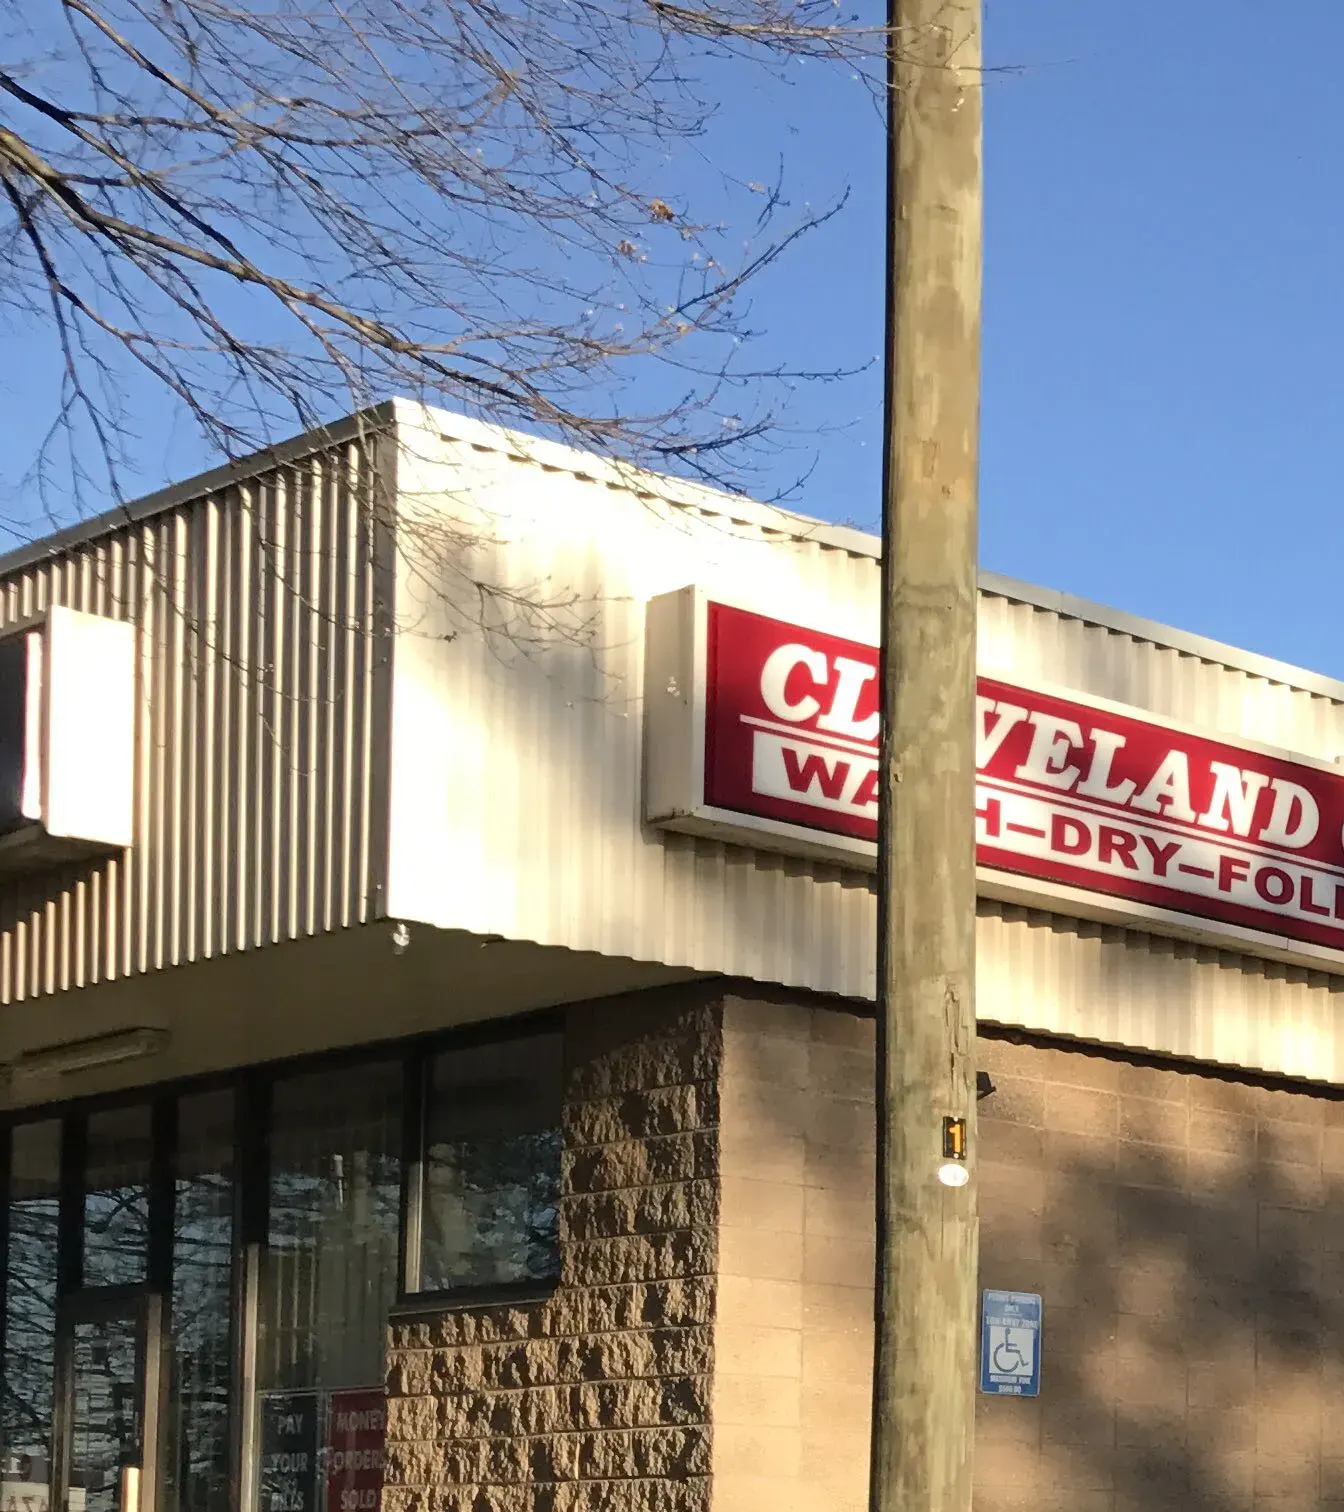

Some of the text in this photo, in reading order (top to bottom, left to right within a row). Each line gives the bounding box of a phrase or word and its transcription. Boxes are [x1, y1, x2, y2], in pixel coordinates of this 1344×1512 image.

[760, 643, 1320, 849] CLVELAND
[949, 1123, 961, 1153] 1
[340, 1489, 376, 1510] SOLD
